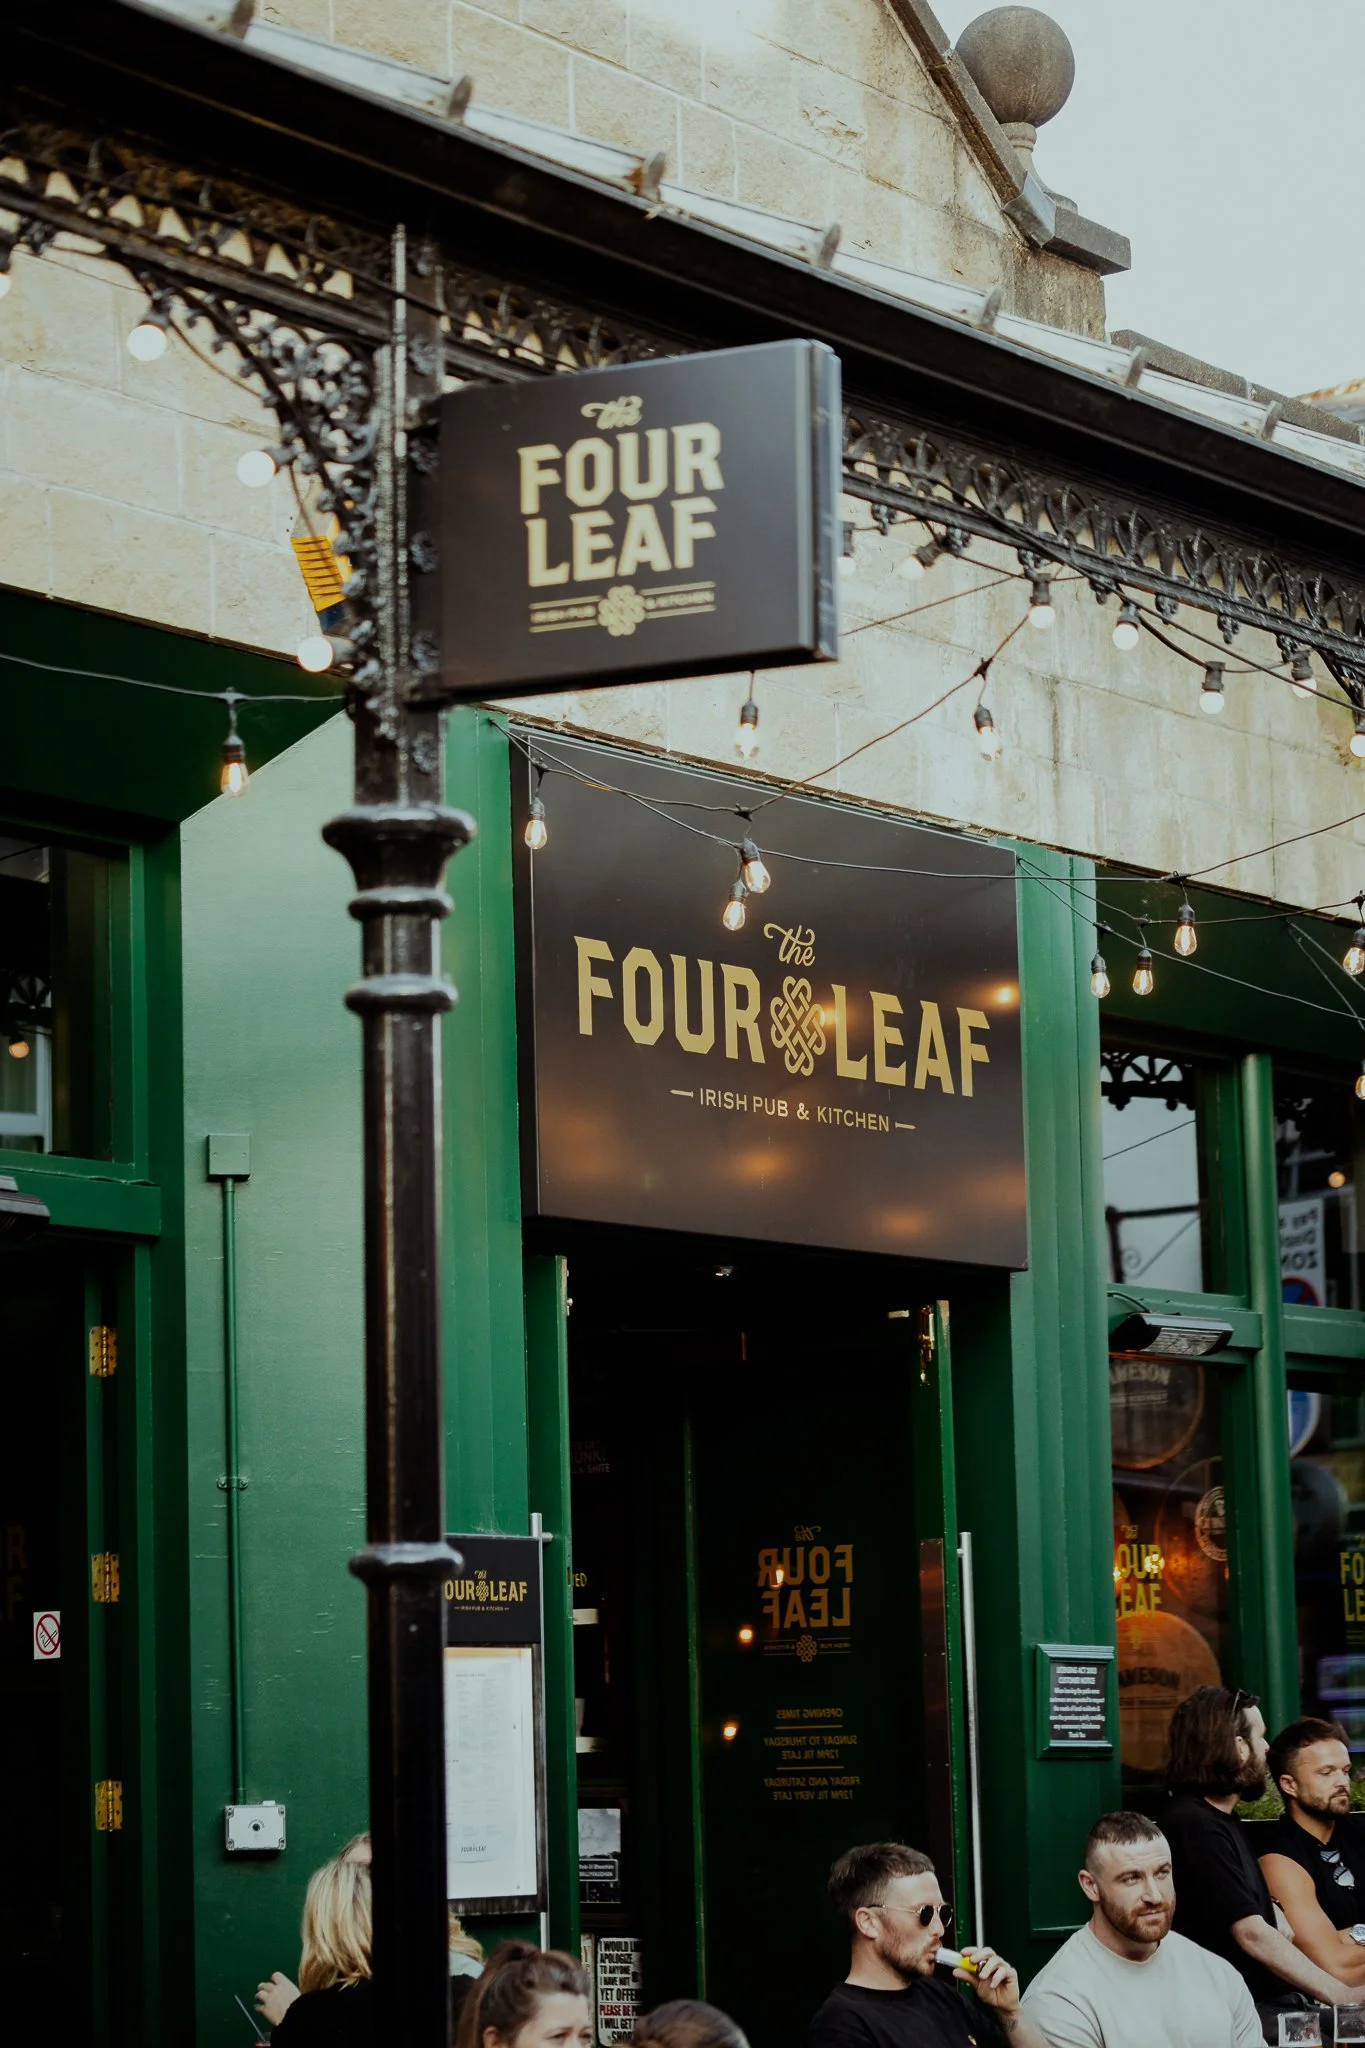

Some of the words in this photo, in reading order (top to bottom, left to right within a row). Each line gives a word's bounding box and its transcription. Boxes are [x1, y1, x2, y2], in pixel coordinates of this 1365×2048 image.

[580, 395, 642, 430] the
[518, 422, 725, 515] FOUR
[525, 497, 718, 587] LEAF
[763, 922, 816, 967] the
[574, 935, 766, 1064] FOUR
[831, 983, 991, 1097] LEAF
[700, 1087, 748, 1112] IRISH
[753, 1096, 788, 1118] PUB
[797, 1103, 810, 1121] &
[817, 1106, 889, 1132] KITCHEN
[1118, 1544, 1163, 1579] OUR
[1339, 1552, 1365, 1585] FO
[444, 1579, 476, 1601] OUR
[489, 1580, 528, 1602] LEAF
[1343, 1589, 1365, 1622] LE
[604, 1941, 629, 1952] WOULD
[599, 1965, 607, 1974] TO
[609, 1965, 630, 1975] ANYONE
[604, 1976, 618, 1986] HAVE
[599, 2005, 621, 2016] PLEASE
[623, 2005, 631, 2016] BE
[600, 1988, 614, 2001] YET
[604, 2018, 619, 2029] WILL
[621, 2018, 631, 2029] GET
